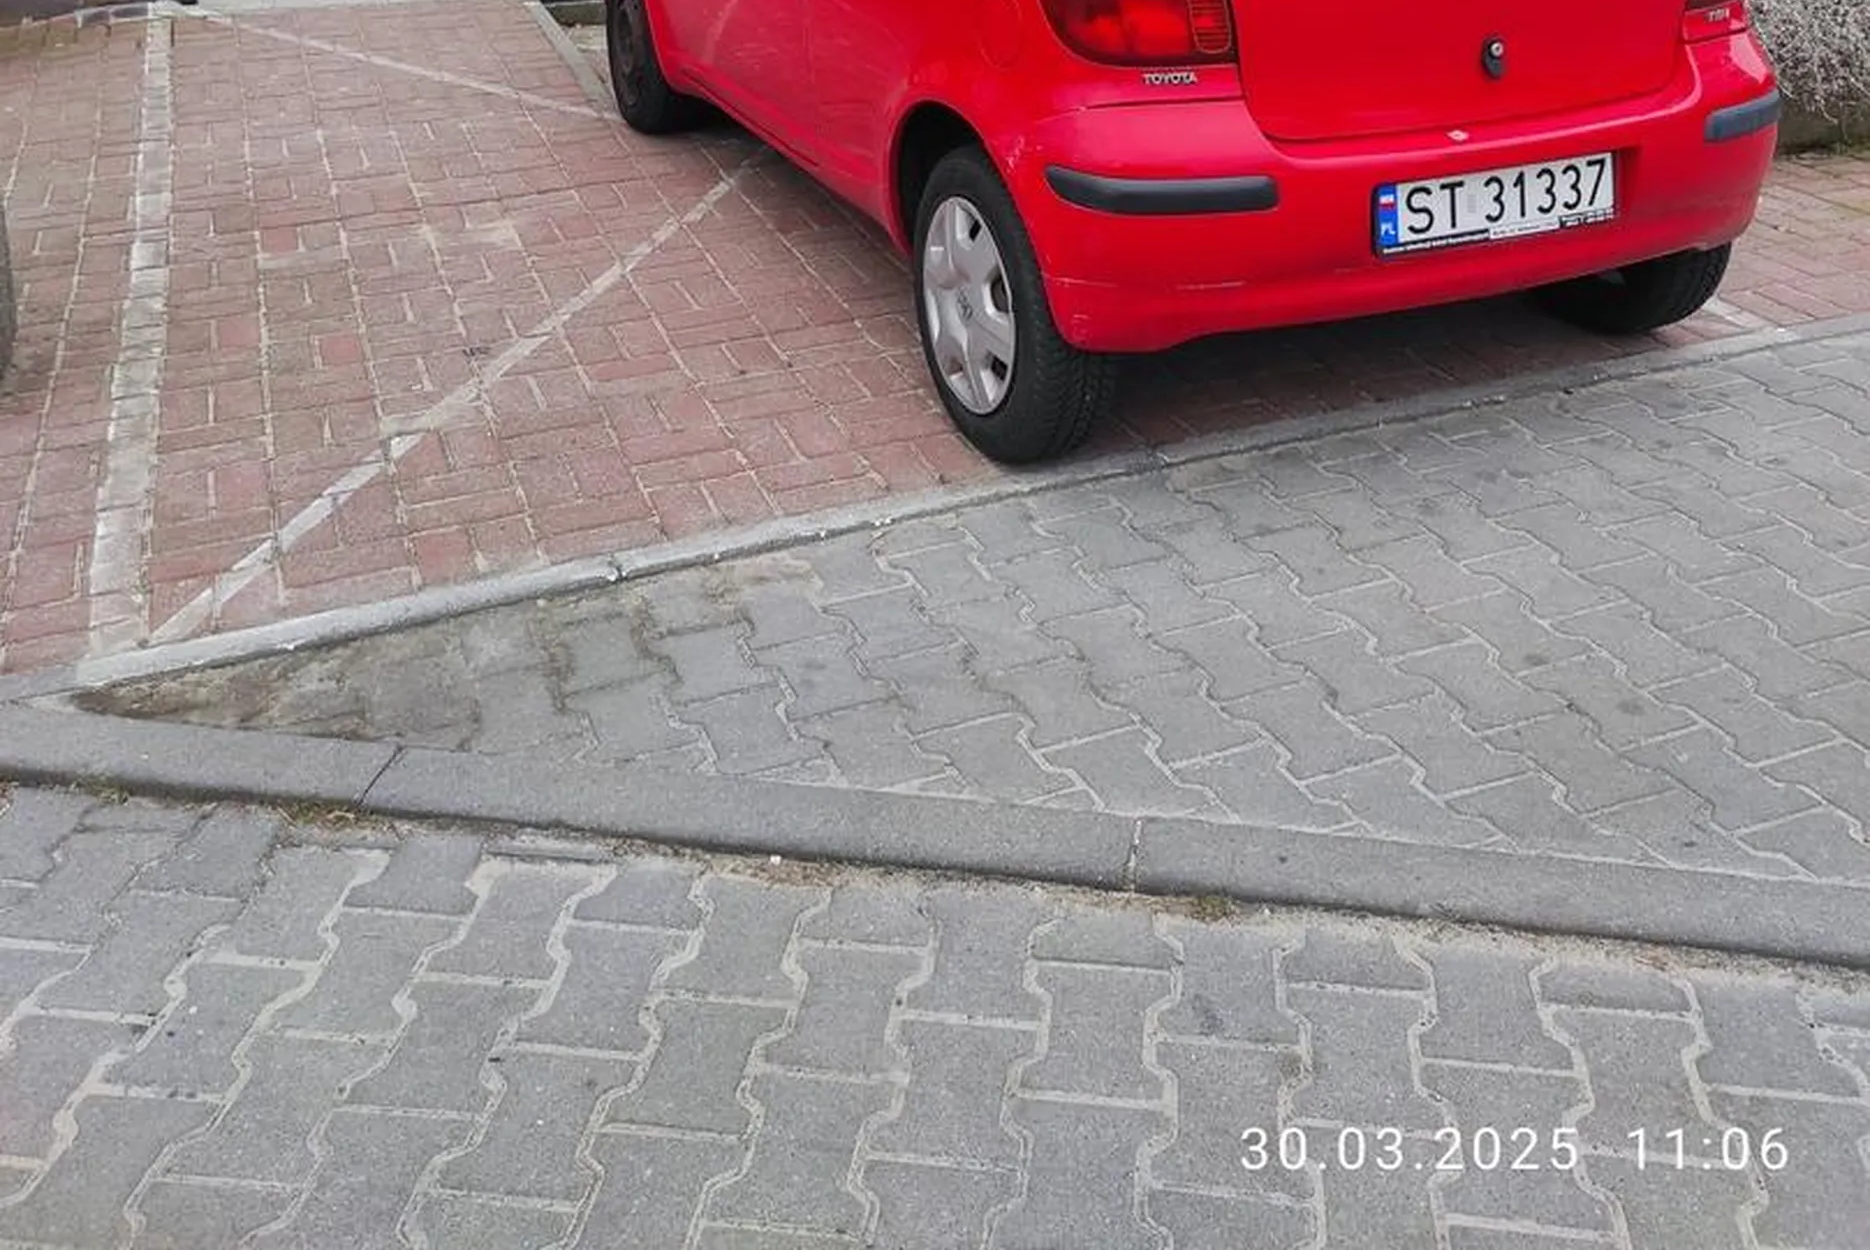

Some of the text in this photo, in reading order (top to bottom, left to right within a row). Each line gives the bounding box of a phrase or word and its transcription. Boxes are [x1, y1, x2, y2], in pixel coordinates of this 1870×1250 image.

[1143, 72, 1198, 84] TOYOTA
[1405, 158, 1606, 234] ST 31337
